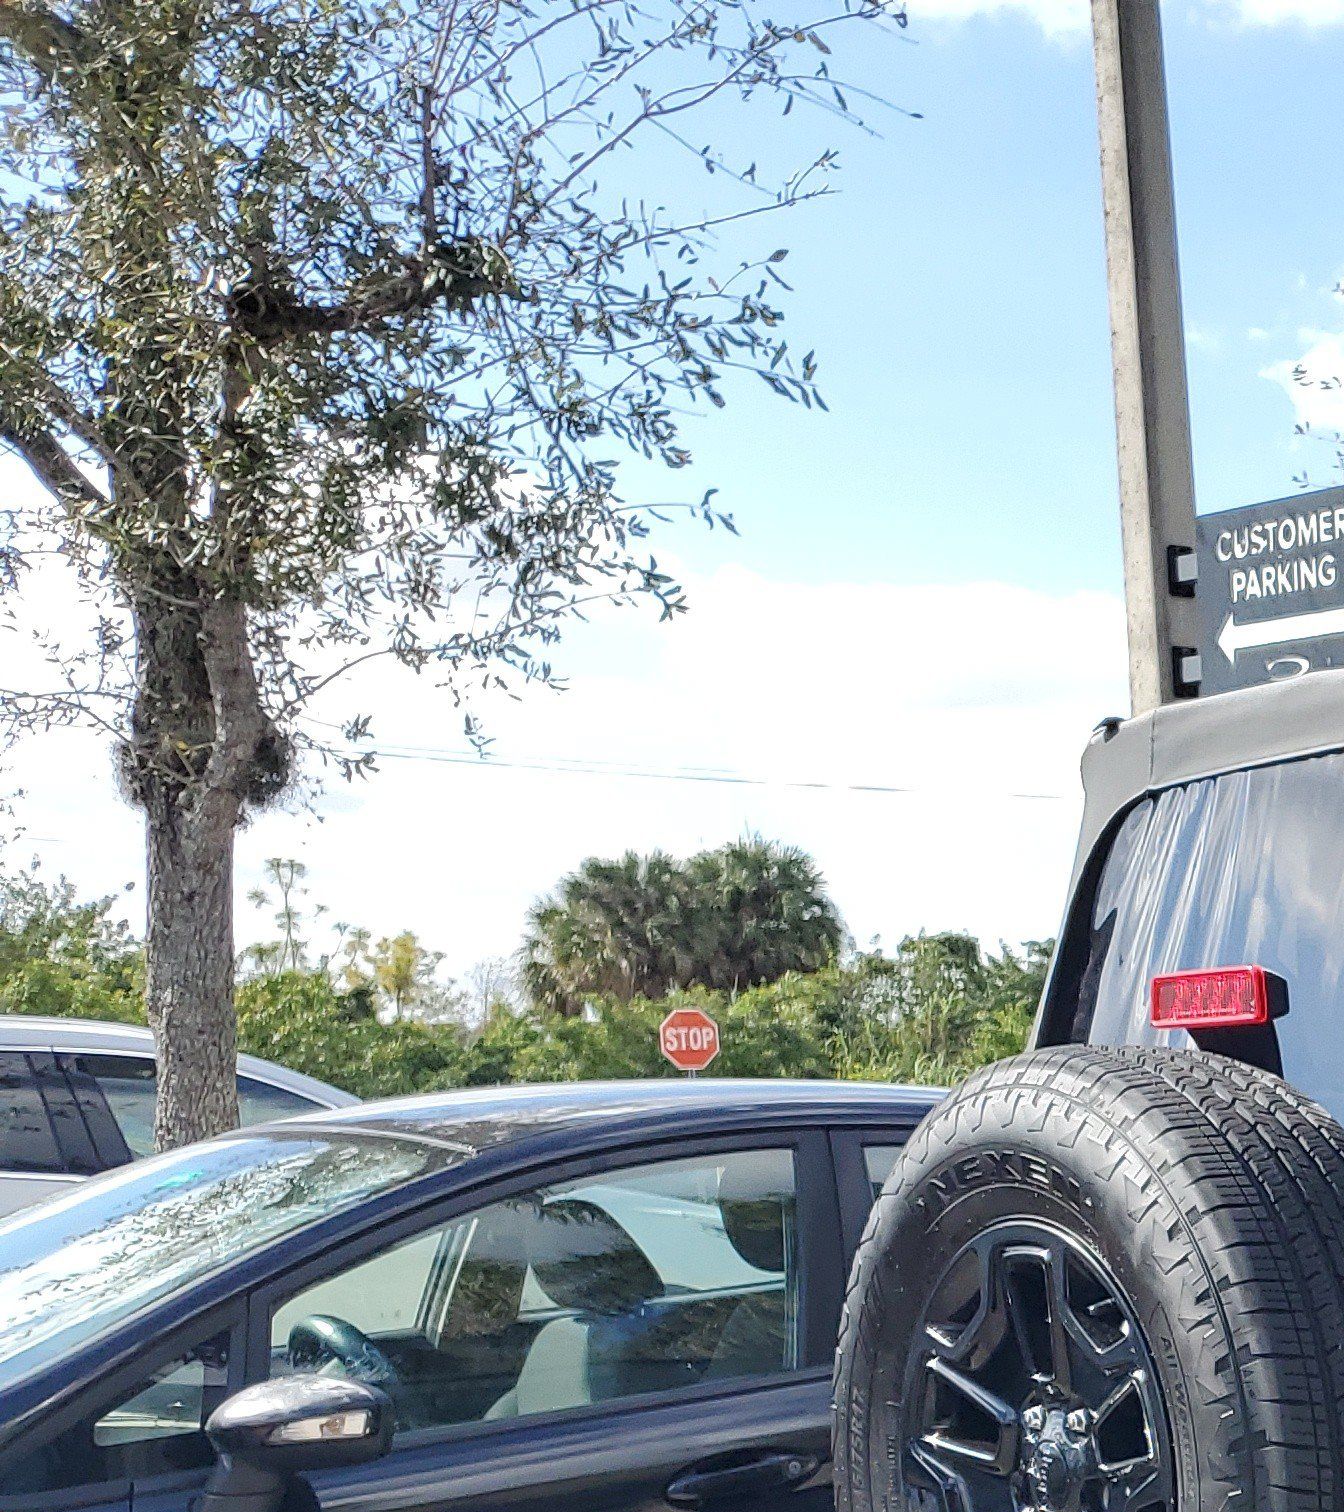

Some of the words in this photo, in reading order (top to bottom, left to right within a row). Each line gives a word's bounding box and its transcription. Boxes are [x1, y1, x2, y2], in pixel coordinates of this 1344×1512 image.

[1232, 555, 1337, 603] PARKING
[666, 1026, 714, 1051] STOP
[930, 1148, 1081, 1214] NEXEN
